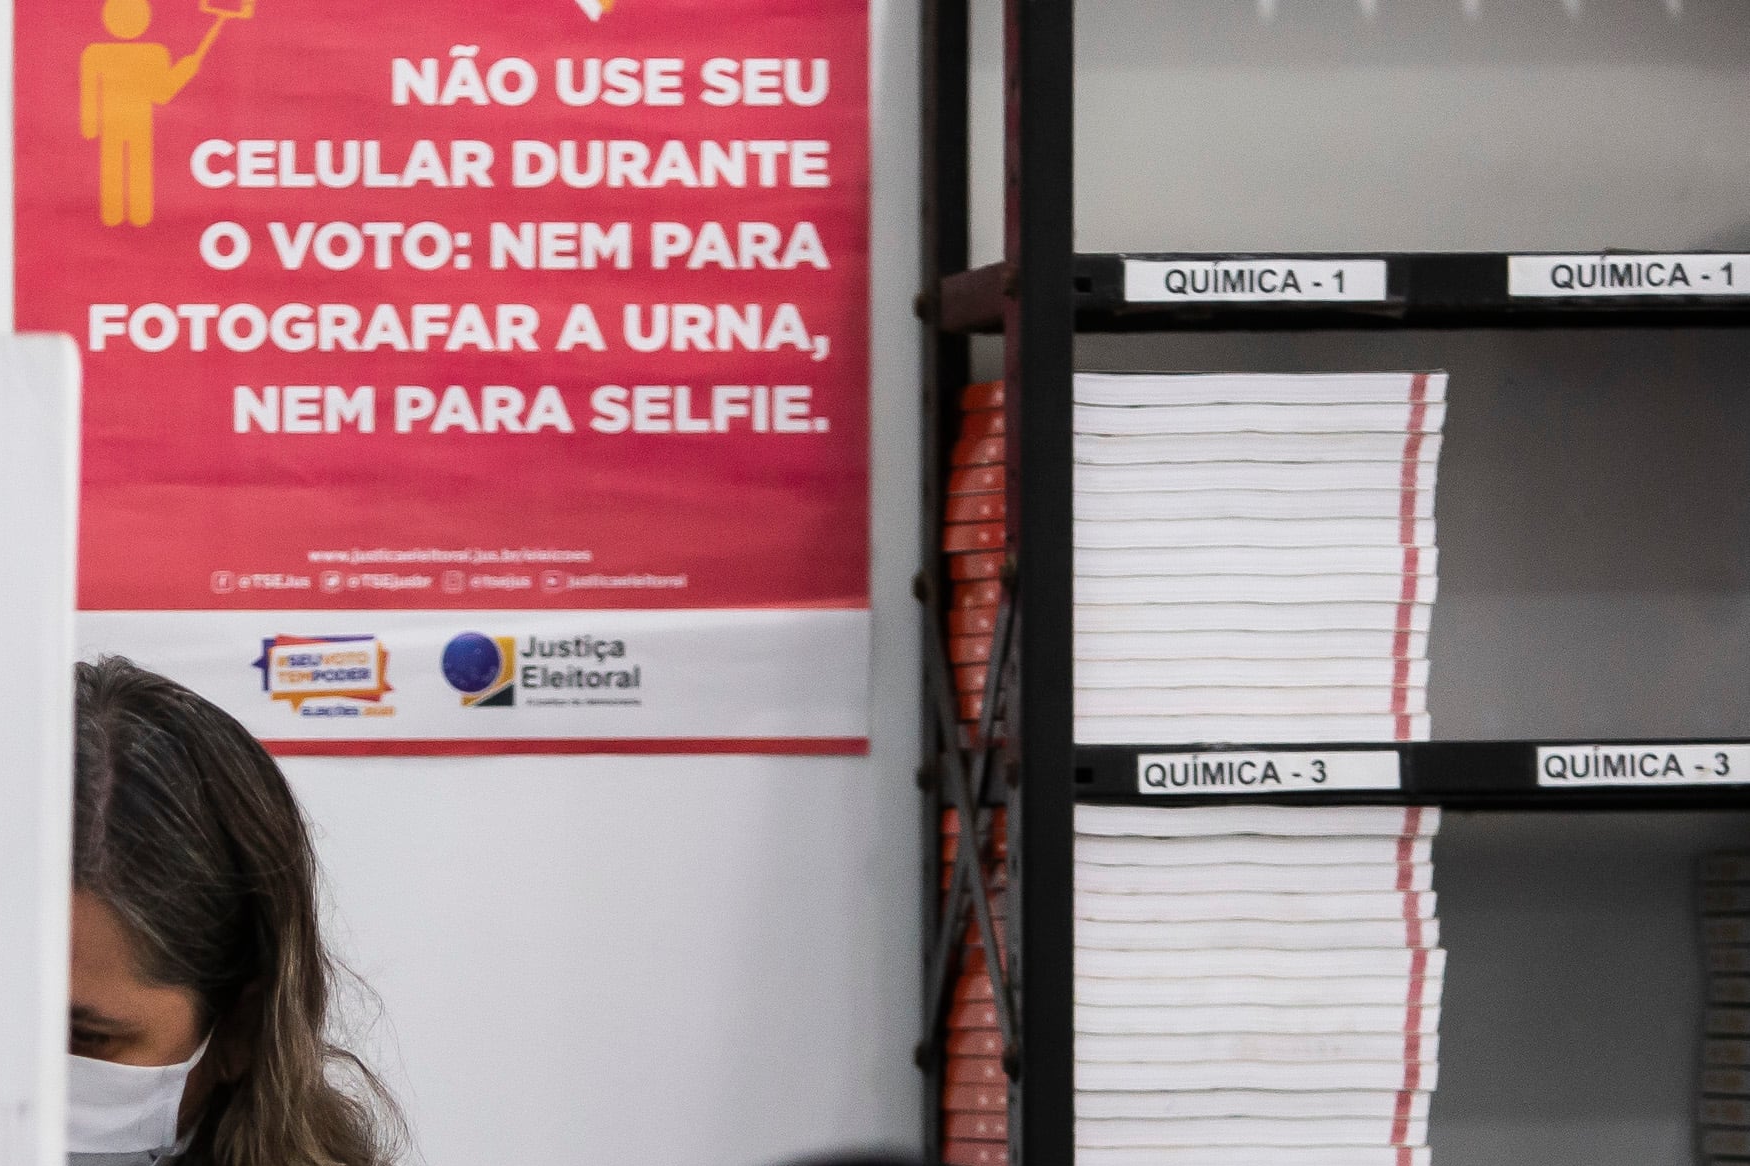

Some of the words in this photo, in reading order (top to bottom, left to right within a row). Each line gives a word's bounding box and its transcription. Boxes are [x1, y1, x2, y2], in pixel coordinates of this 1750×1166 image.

[391, 44, 538, 107] NÃO
[555, 57, 685, 107] USE
[700, 57, 830, 107] SEU
[189, 139, 496, 189] CELULAR
[511, 139, 831, 189] DURANTE
[199, 221, 252, 271] O
[268, 221, 472, 271] VOTO:
[489, 221, 633, 271] NEM
[650, 221, 832, 271] PARA
[1164, 262, 1301, 295] QUÍMICA
[1332, 269, 1346, 293] 1
[1551, 256, 1691, 290] QUÍMICA
[1720, 262, 1733, 286] 1
[88, 302, 540, 353] FOTOGRAFAR
[556, 303, 608, 352] A
[622, 302, 830, 360] URNA,
[233, 385, 376, 434] NEM
[394, 385, 574, 434] PARA
[589, 384, 830, 434] SELFIE.
[521, 634, 626, 662] Justiça
[521, 664, 641, 689] Eleitoral
[1144, 755, 1282, 788] QUÍMICA
[1311, 759, 1327, 783] 3
[1544, 748, 1684, 779] QUÍMICA
[1714, 752, 1730, 776] 3
